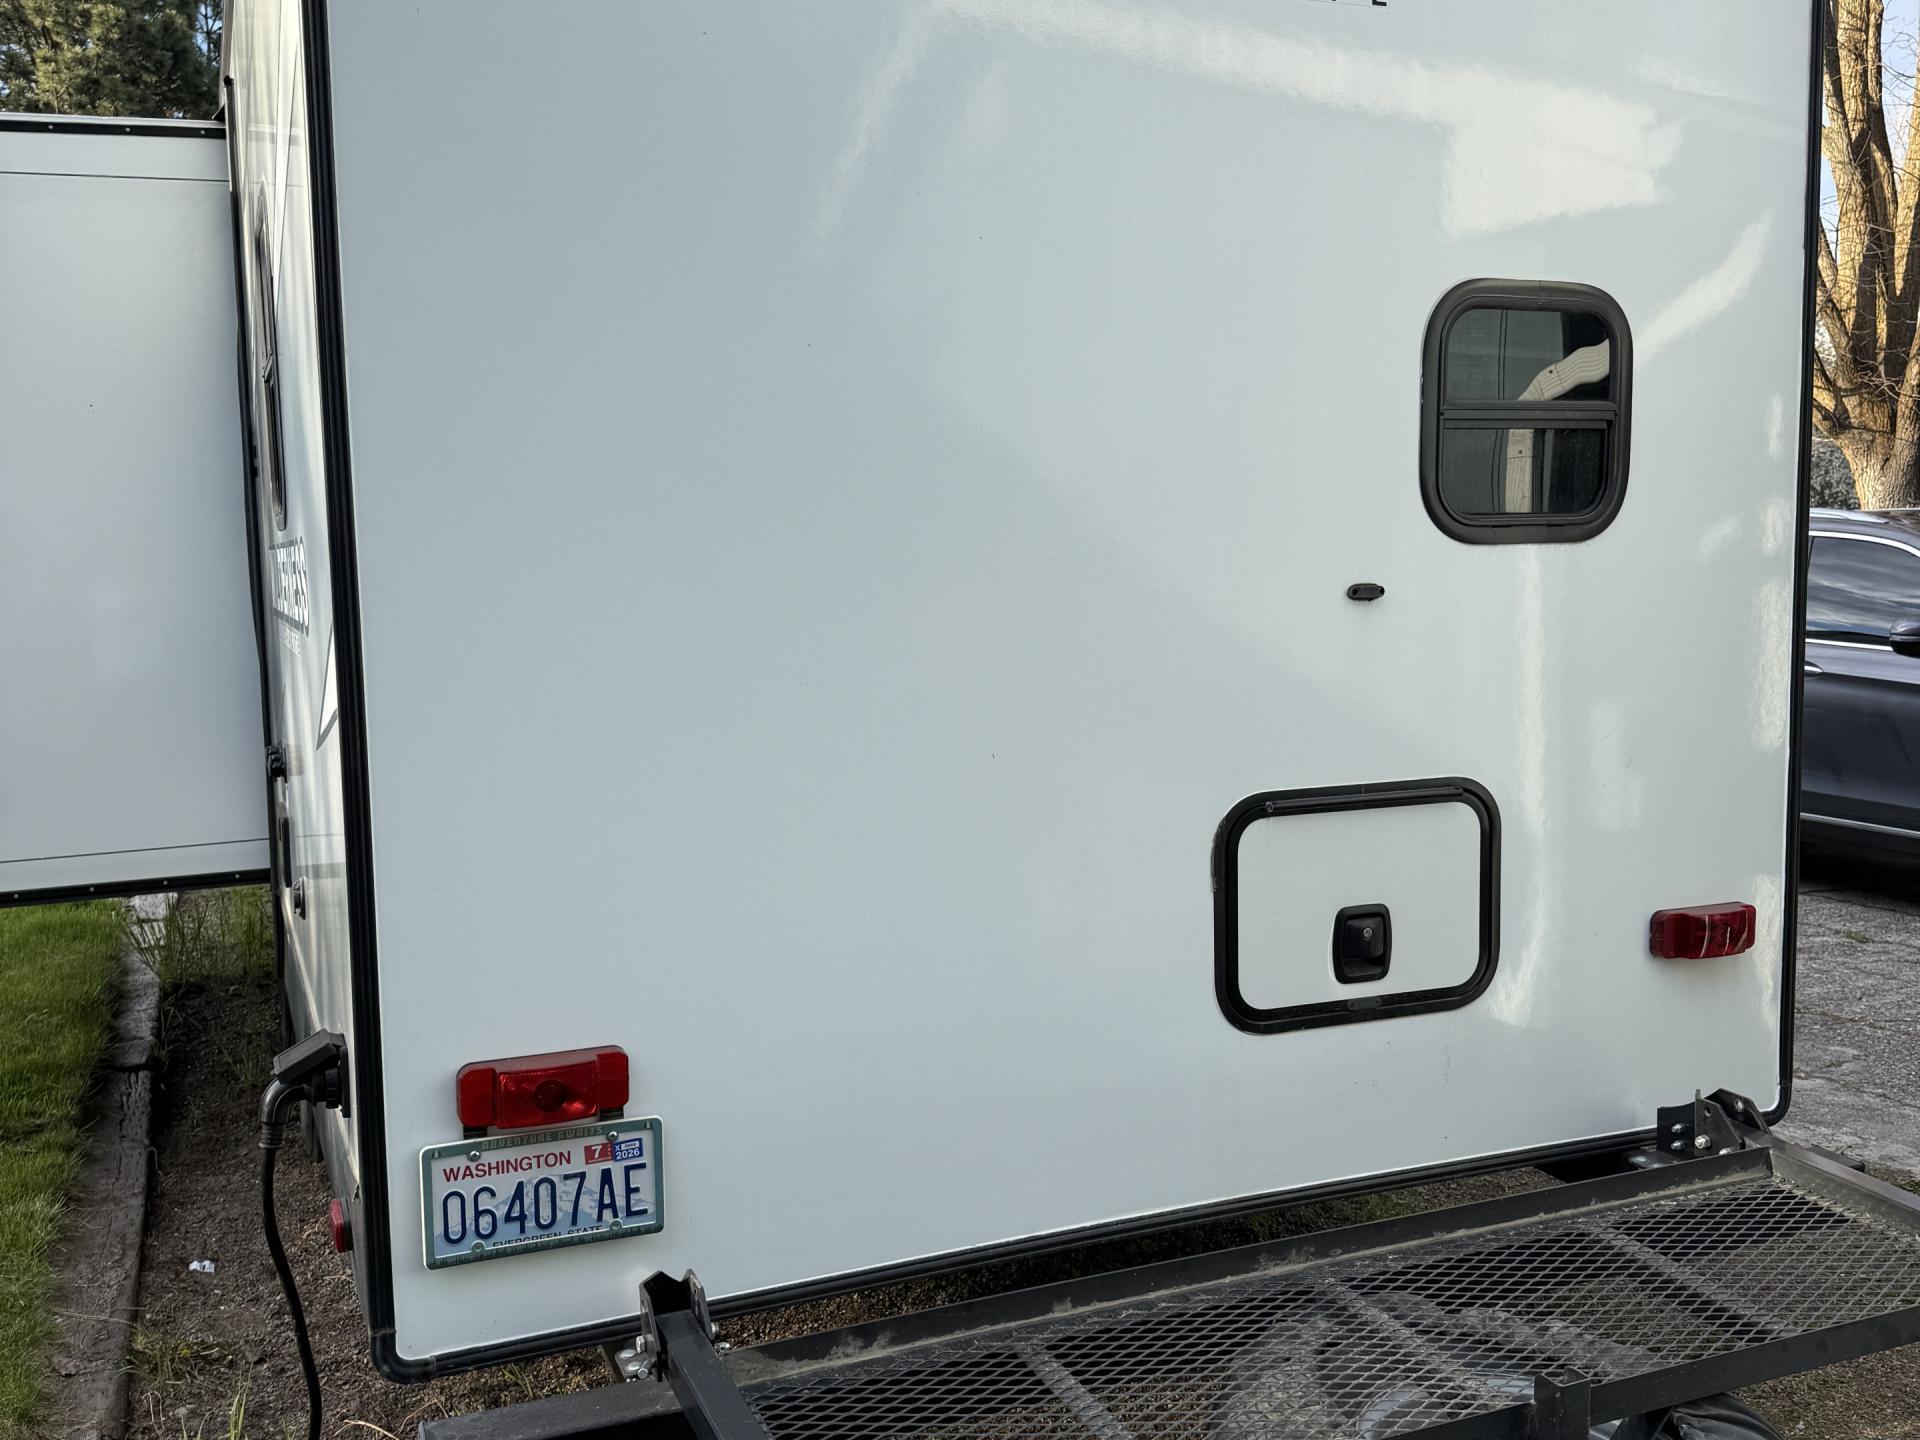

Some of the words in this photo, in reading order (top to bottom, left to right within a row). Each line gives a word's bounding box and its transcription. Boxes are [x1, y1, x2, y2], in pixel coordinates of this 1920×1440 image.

[482, 1132, 553, 1151] ADVENTURE
[558, 1125, 604, 1139] AWAITS
[591, 1145, 602, 1159] 7
[616, 1148, 640, 1160] 2026
[443, 1151, 571, 1183] WASHINGTON
[442, 1163, 648, 1245] 06407AE
